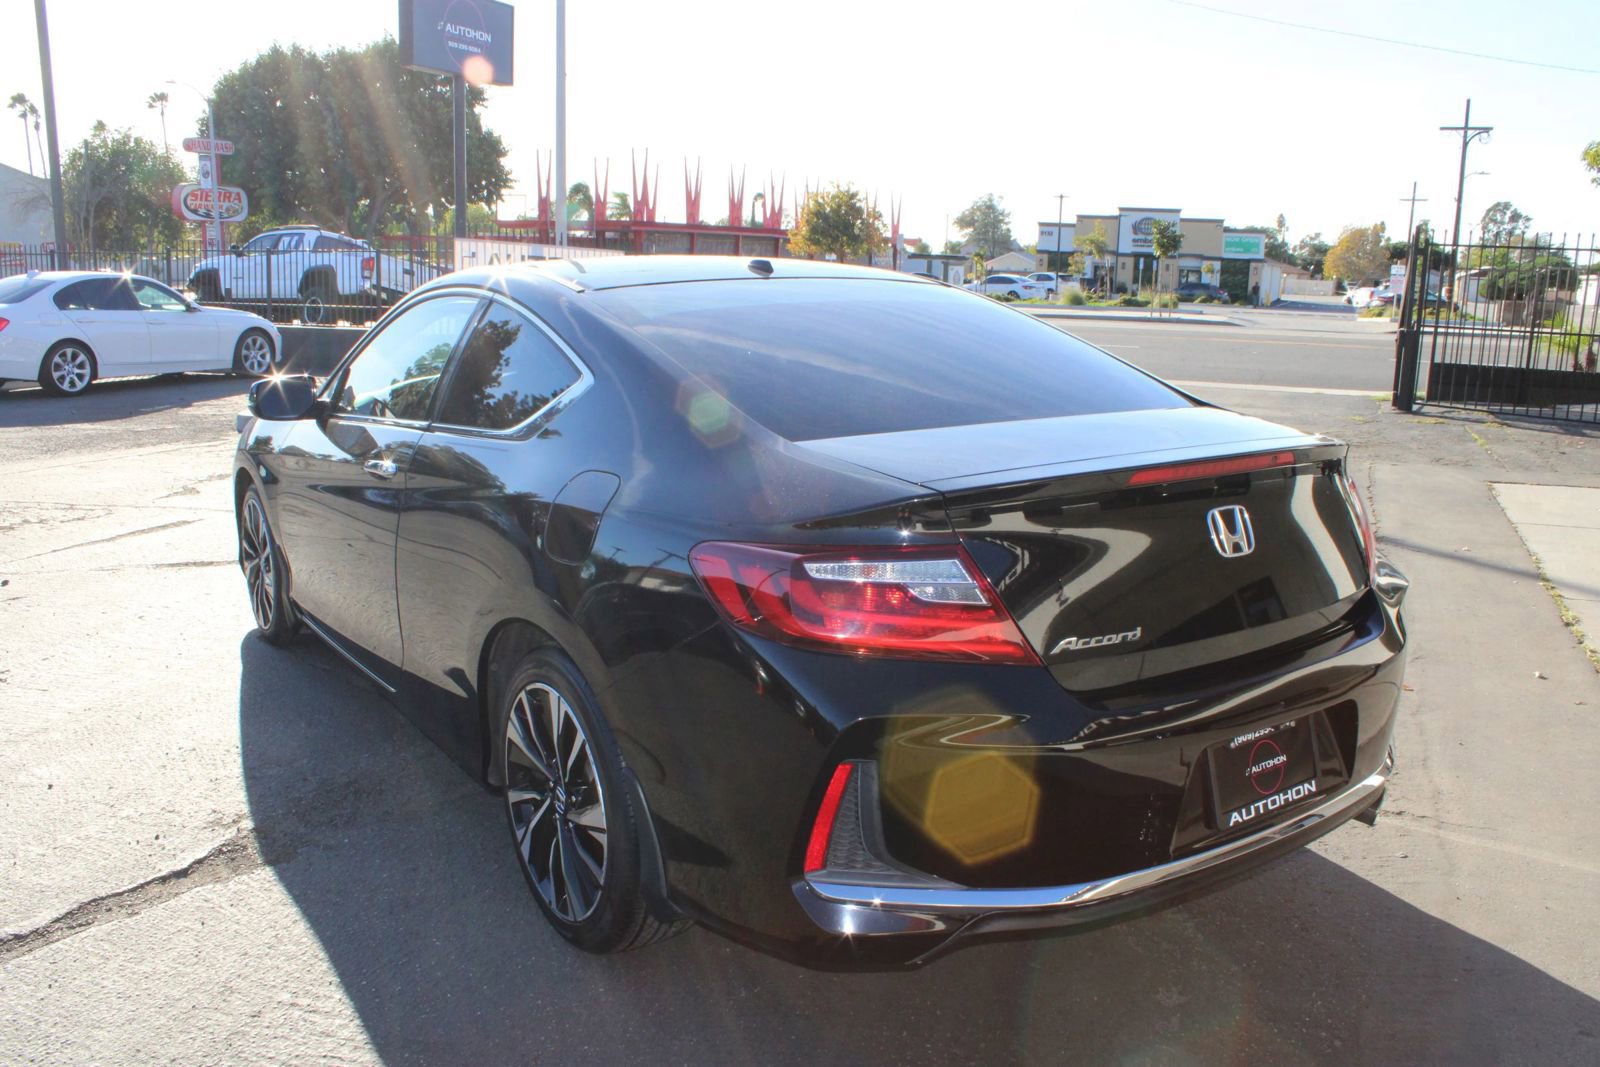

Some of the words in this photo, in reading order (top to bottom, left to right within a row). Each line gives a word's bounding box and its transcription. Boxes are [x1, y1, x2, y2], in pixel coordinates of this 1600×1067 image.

[445, 23, 492, 43] AUTOHON
[1050, 626, 1142, 655] Accord
[1250, 754, 1287, 774] AUTOHON
[1229, 780, 1317, 827] AUTOHON
